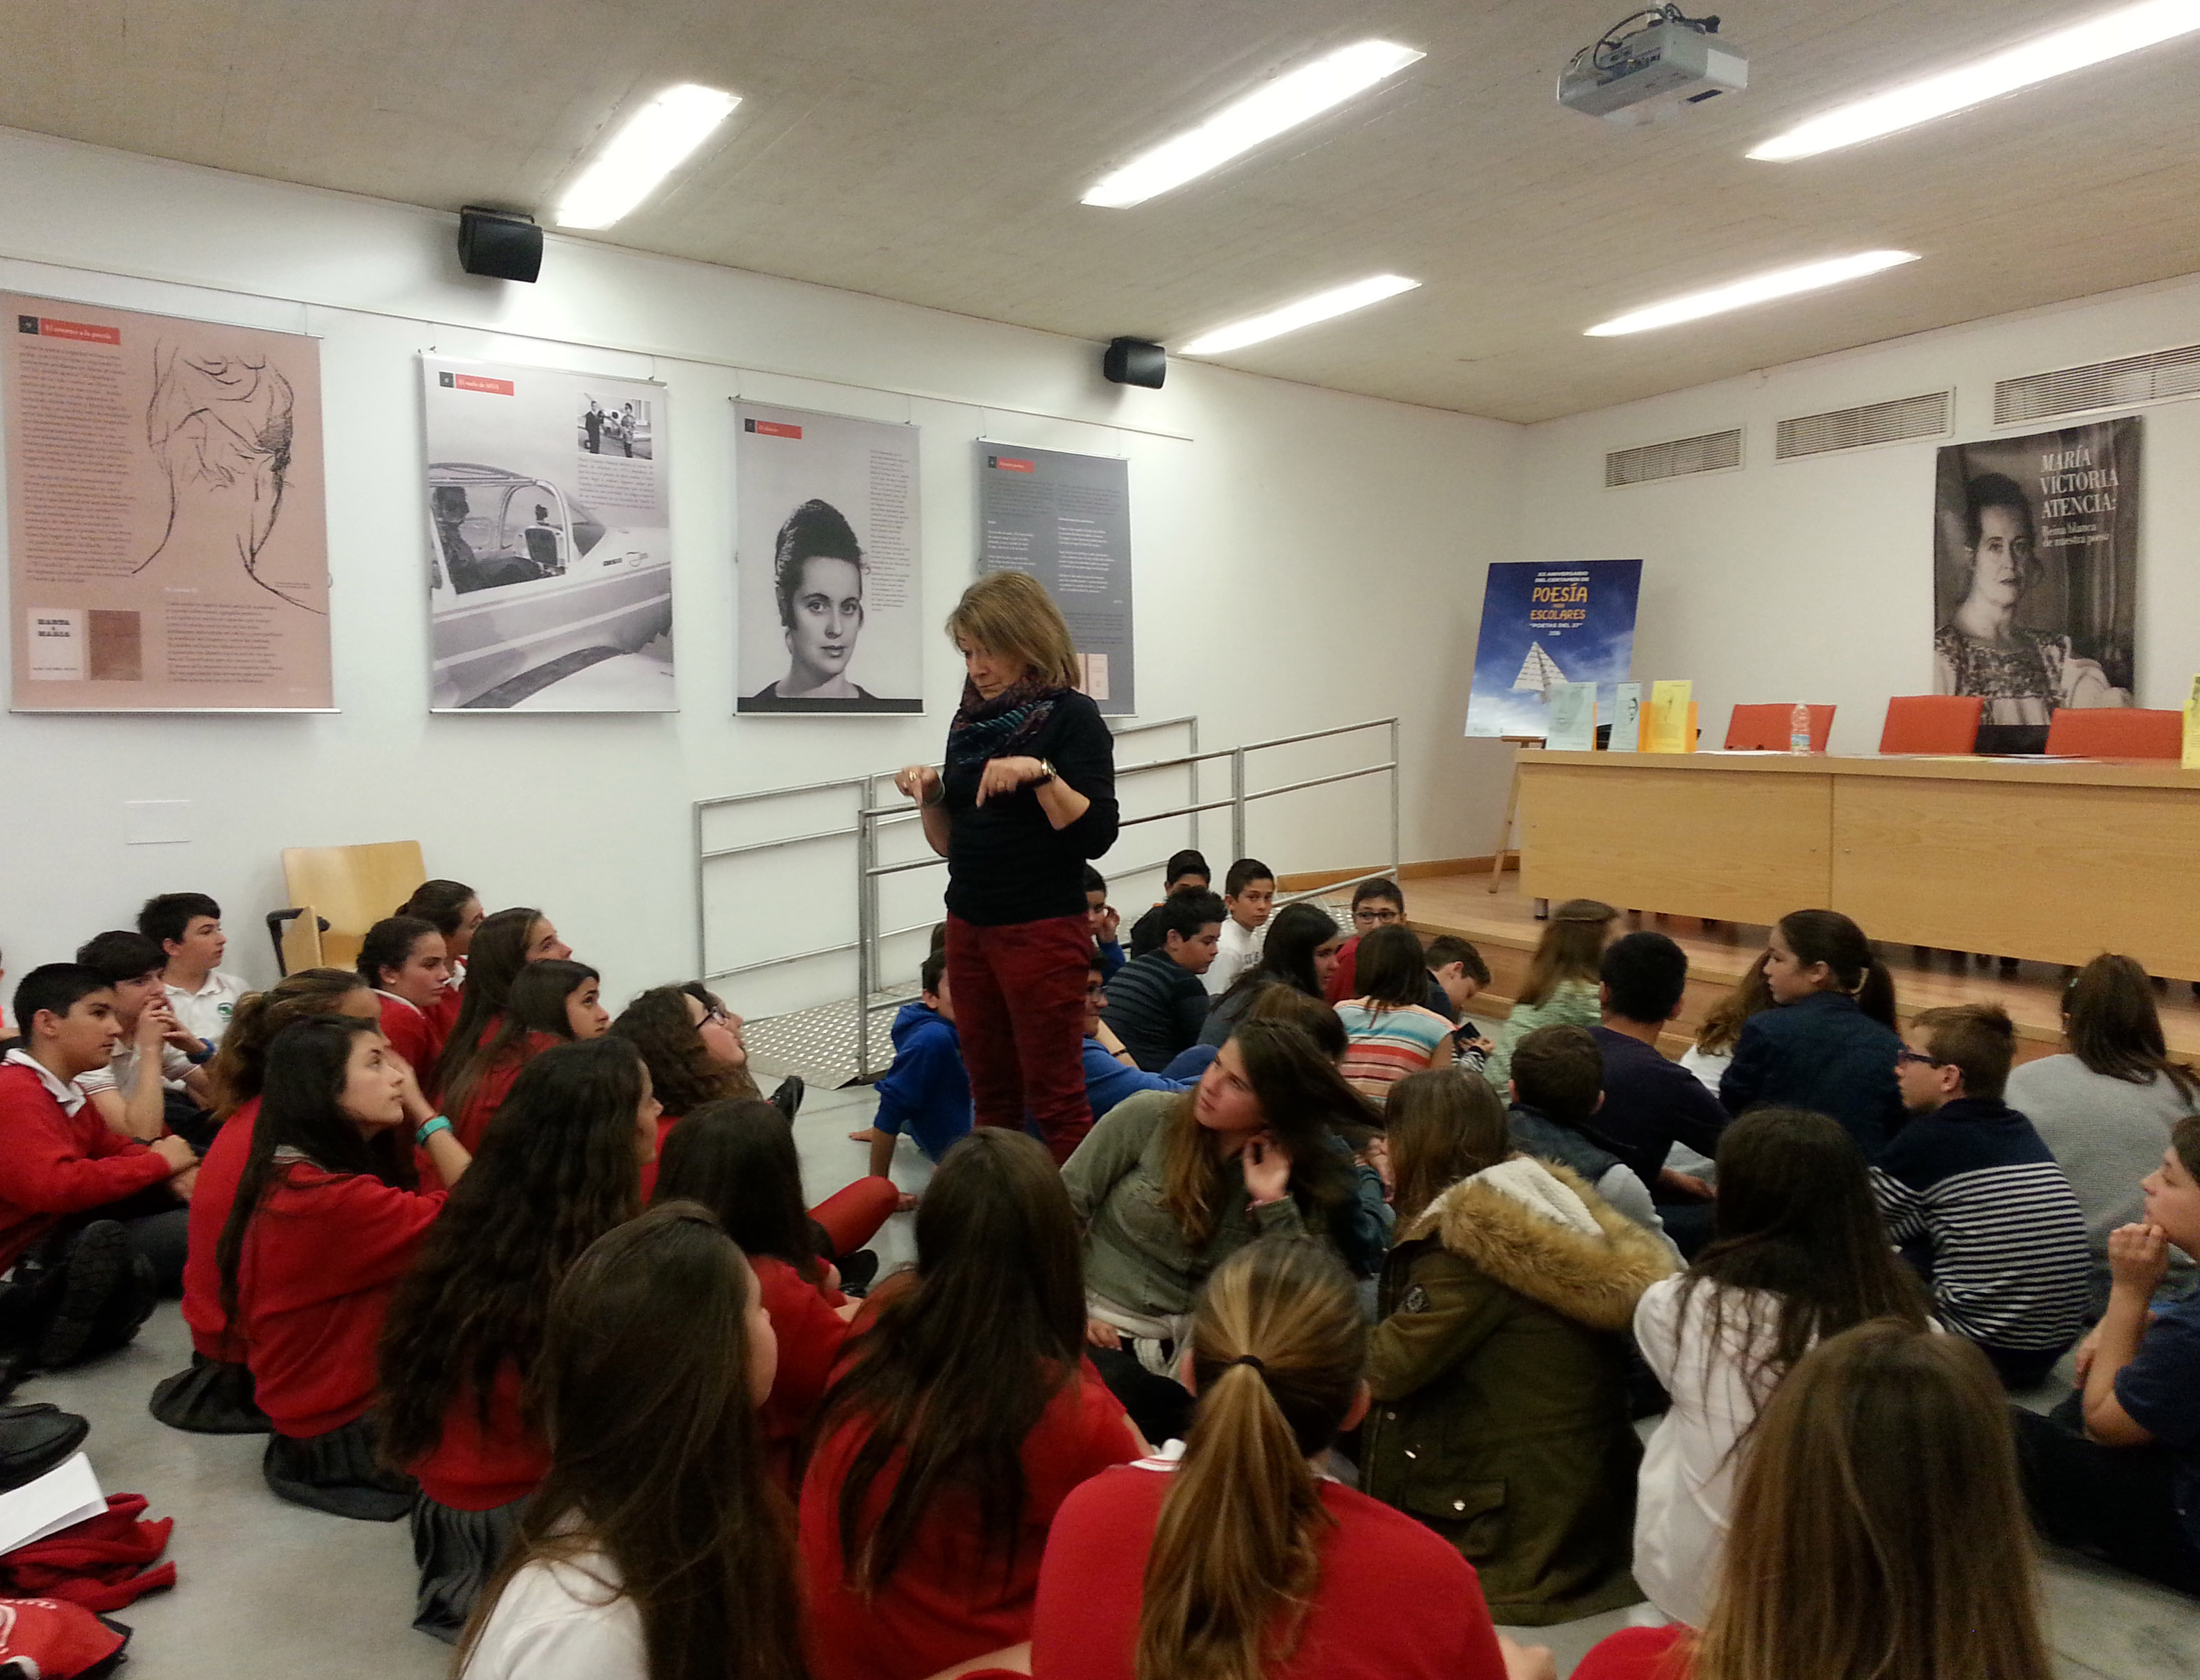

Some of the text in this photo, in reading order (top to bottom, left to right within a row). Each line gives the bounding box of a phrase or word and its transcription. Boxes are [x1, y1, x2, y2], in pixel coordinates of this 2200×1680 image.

[2040, 445, 2092, 473] MARÍA
[2040, 468, 2119, 495] VICTORIA
[2041, 492, 2117, 519] ATENCIA:
[1531, 583, 1588, 603] POESÍA
[1529, 609, 1586, 621] ESCOLARES
